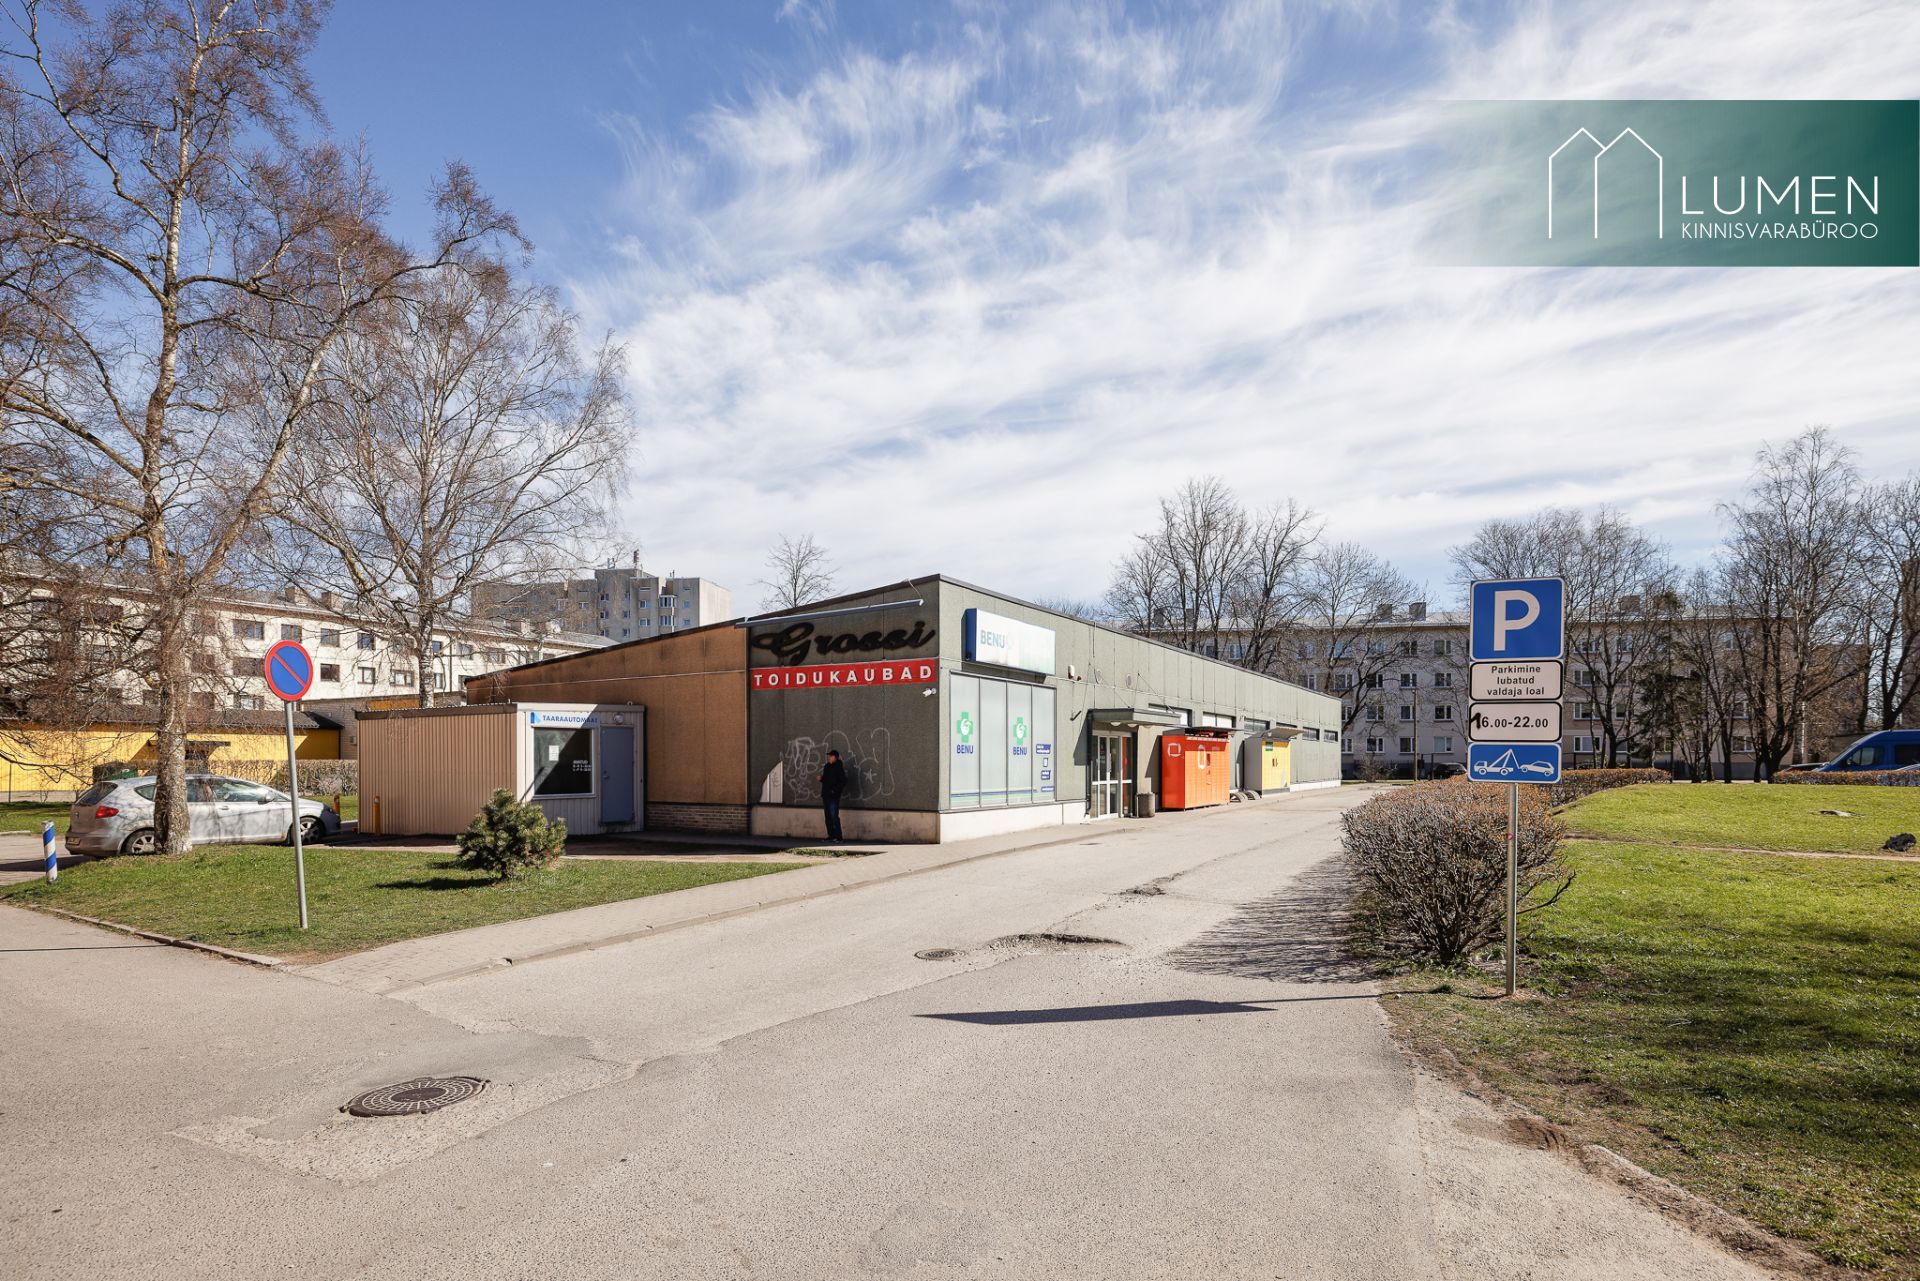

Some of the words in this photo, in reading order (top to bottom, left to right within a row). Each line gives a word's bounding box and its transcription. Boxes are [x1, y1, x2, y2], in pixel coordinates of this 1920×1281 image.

[1493, 589, 1541, 652] P
[752, 621, 936, 666] Grossi
[980, 629, 1005, 648] BENU
[1491, 665, 1541, 674] Parkimine
[754, 665, 932, 687] TOIDUKAUBAD
[1497, 676, 1535, 685] lubatud
[1487, 687, 1523, 697] valdaja
[1526, 687, 1545, 696] loal
[956, 744, 974, 754] BENU
[1012, 746, 1028, 756] BENU
